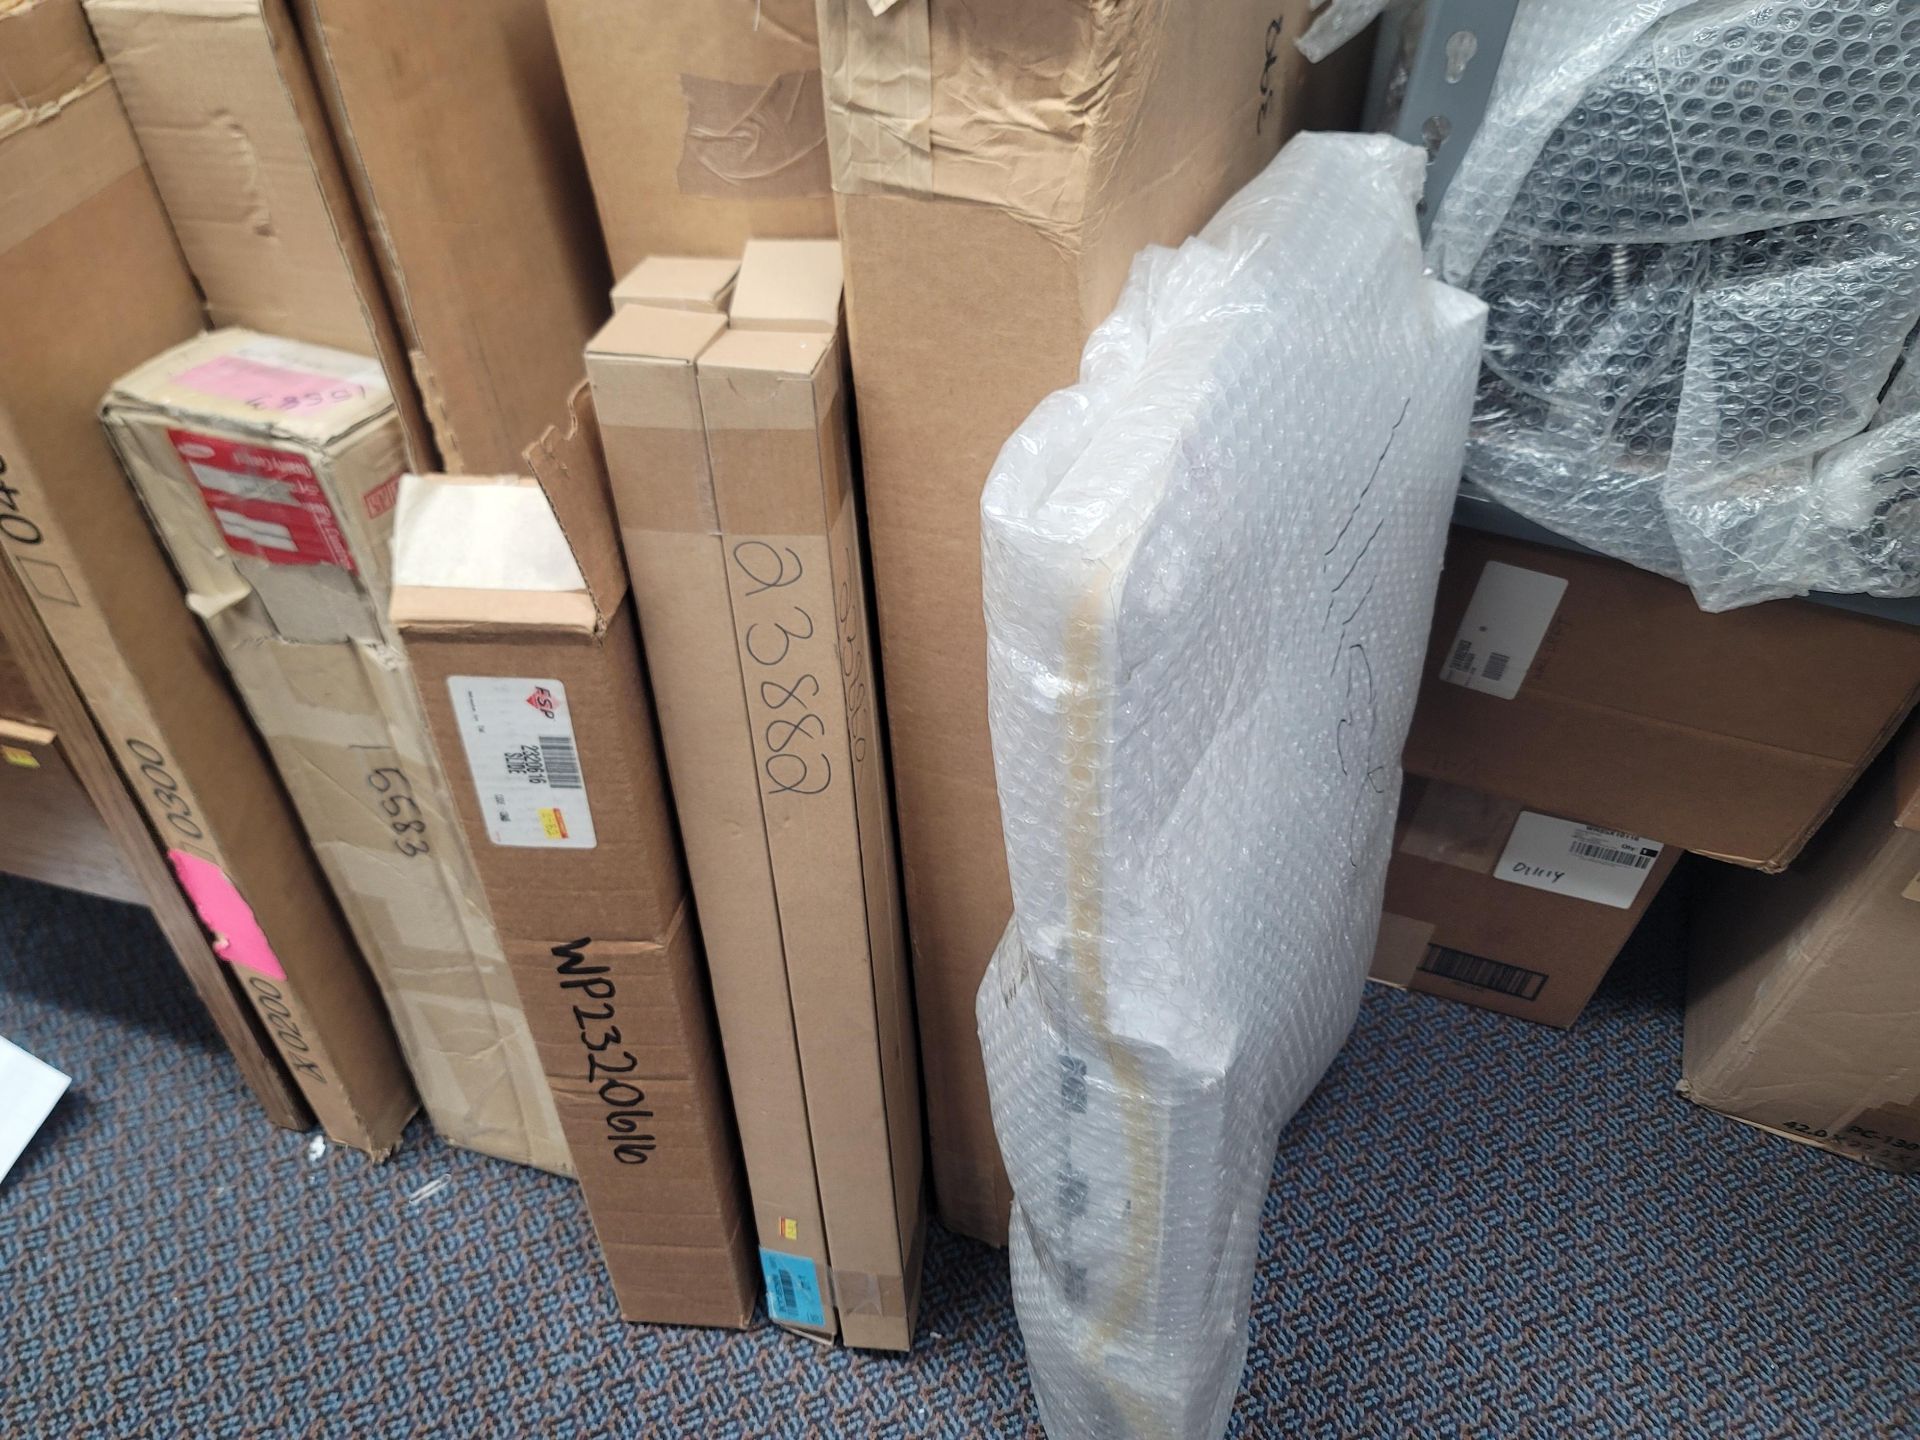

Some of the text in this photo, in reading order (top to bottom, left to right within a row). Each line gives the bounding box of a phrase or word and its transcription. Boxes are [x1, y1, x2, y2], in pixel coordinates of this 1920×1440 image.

[127, 738, 203, 839] 0300
[503, 752, 527, 775] SLIDE
[520, 744, 548, 785] 2320616
[249, 977, 309, 1052] 0200
[550, 936, 657, 1165] WP2320616
